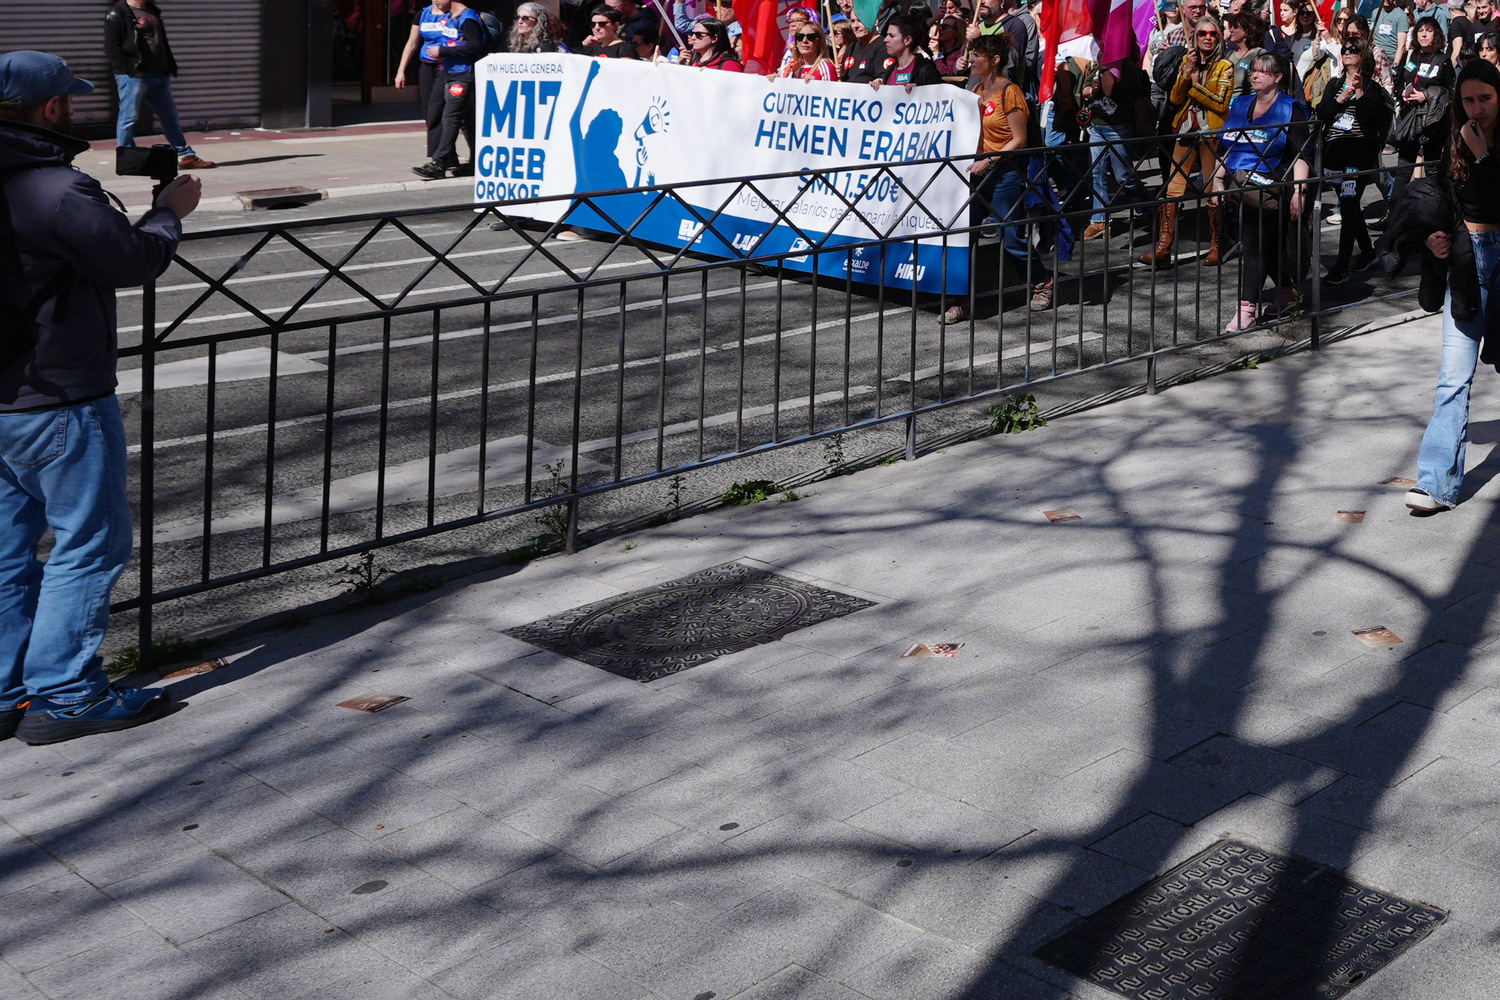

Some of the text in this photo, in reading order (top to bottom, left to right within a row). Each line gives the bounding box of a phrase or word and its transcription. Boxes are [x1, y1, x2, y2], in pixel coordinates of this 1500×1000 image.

[499, 64, 529, 74] HUELGA
[530, 64, 563, 74] GENERA
[482, 80, 562, 140] M17
[763, 91, 954, 125] GUTXIENEKO SOLDATA
[754, 119, 952, 162] HEMEN ERABAKI
[478, 145, 545, 181] GREB
[1147, 893, 1219, 930] VITORIA
[1177, 901, 1247, 943] GASTEIZ
